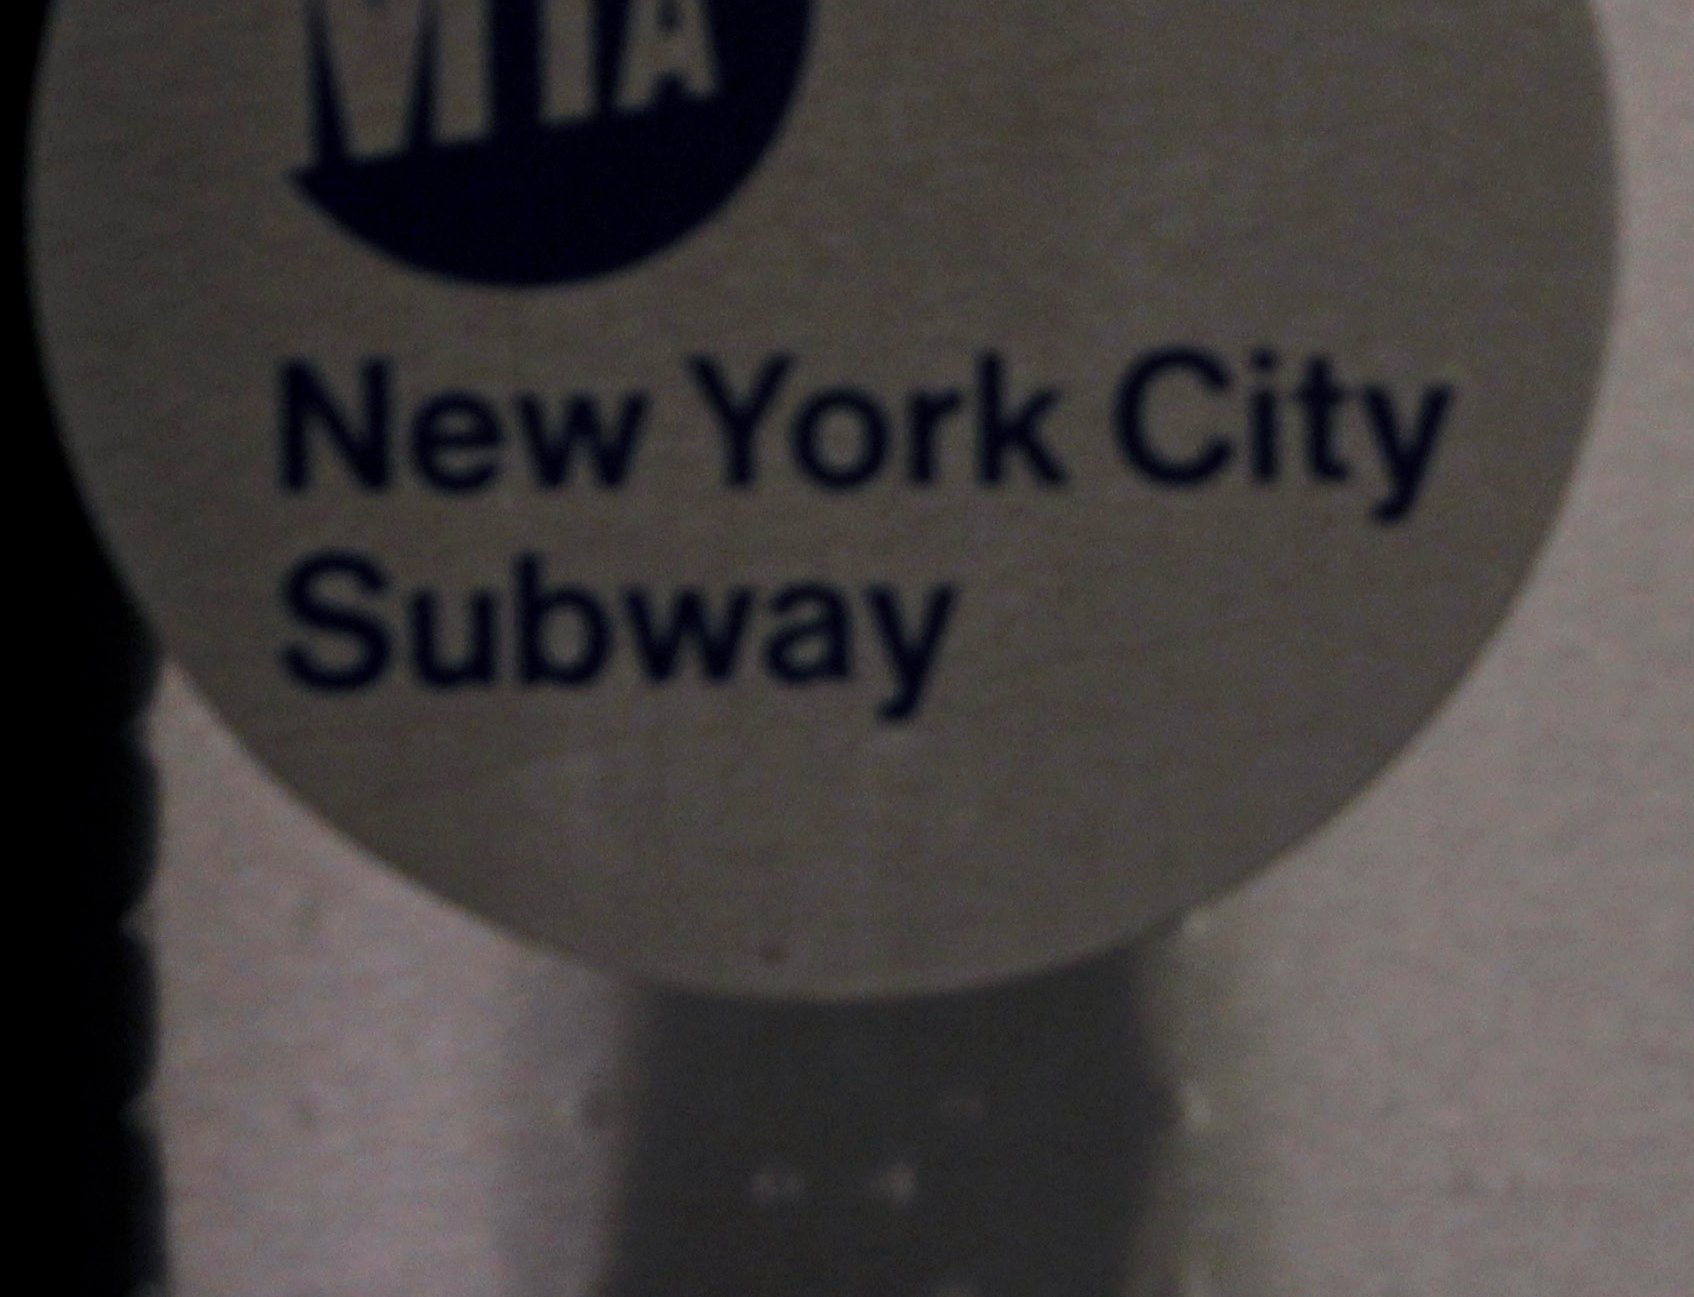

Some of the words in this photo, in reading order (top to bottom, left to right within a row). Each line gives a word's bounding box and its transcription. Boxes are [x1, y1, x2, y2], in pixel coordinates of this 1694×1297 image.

[274, 354, 653, 495] New
[687, 351, 1068, 494] York
[1112, 346, 1453, 526] City
[278, 549, 958, 724] Subway
